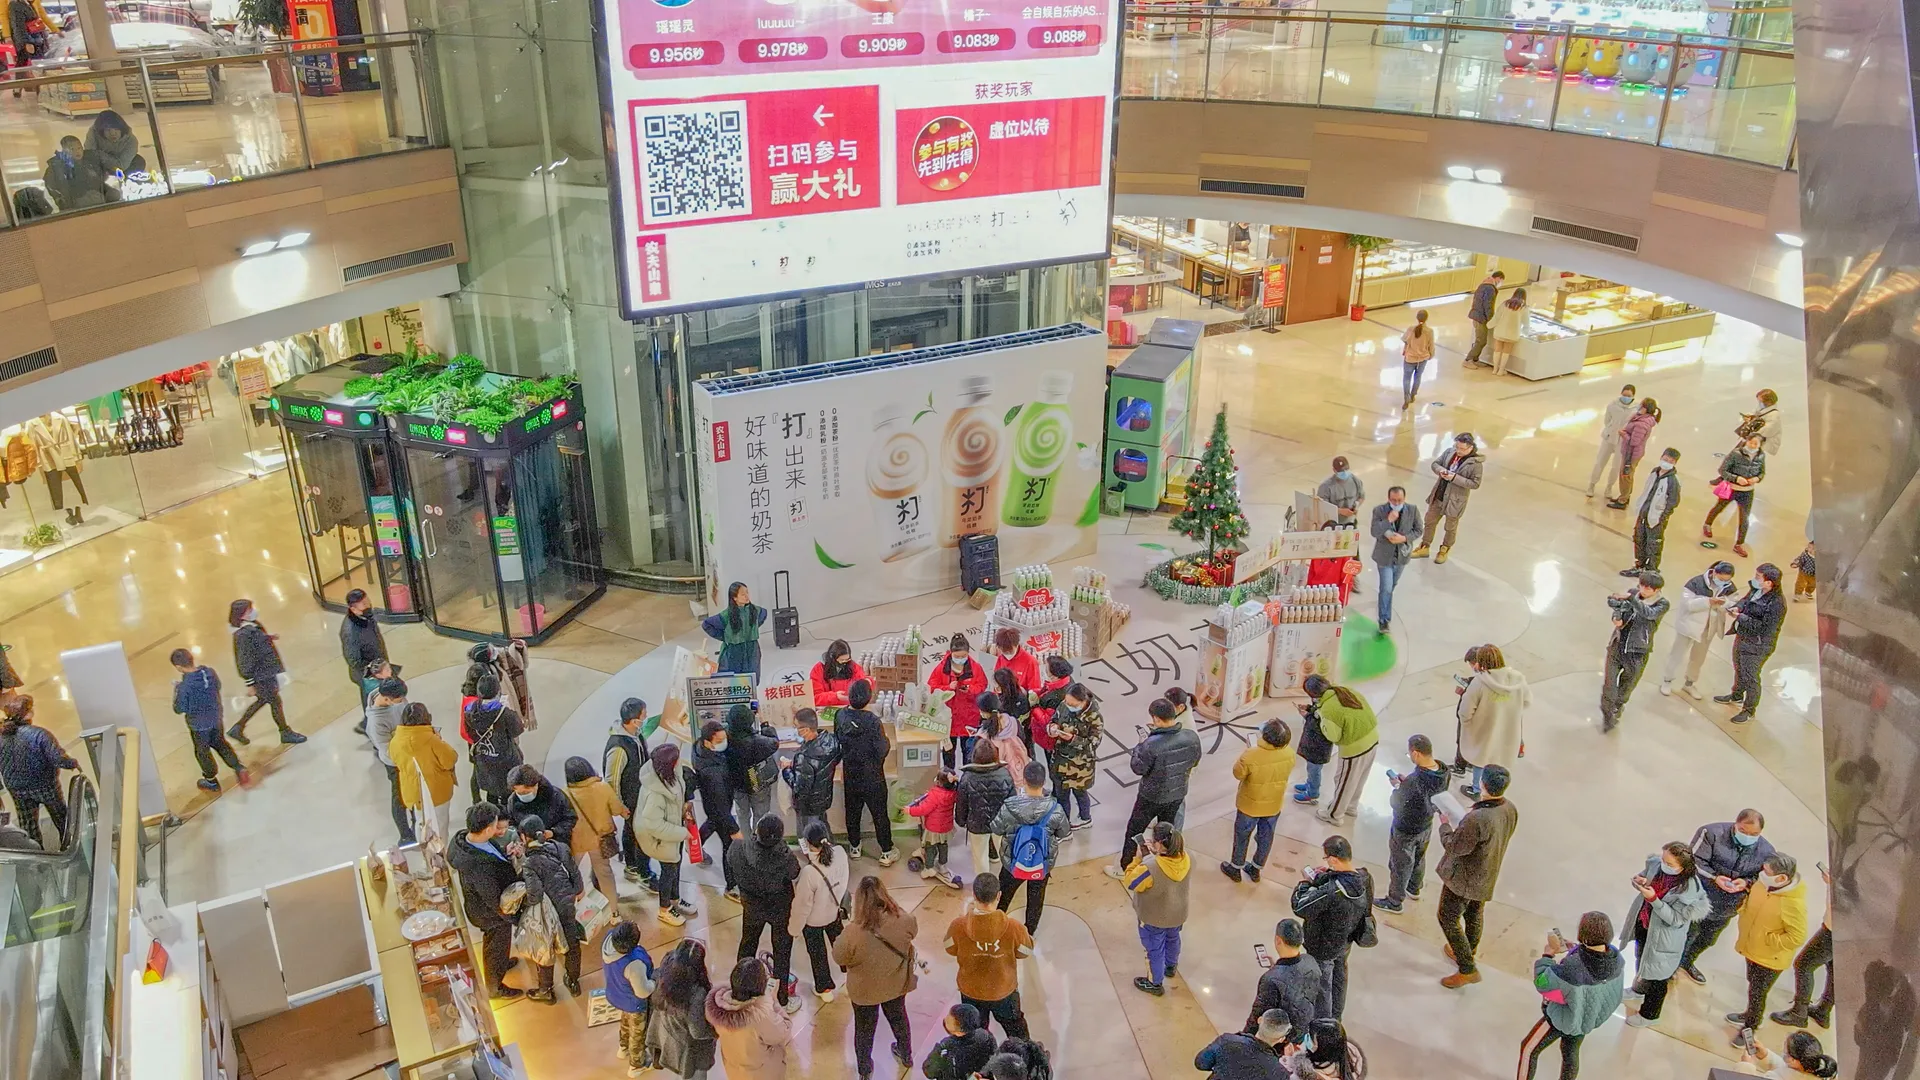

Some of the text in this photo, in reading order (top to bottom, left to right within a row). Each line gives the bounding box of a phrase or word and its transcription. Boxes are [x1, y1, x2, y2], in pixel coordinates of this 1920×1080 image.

[858, 37, 907, 53] 9.909秒
[953, 33, 1000, 48] 9.083秒
[1043, 29, 1087, 44] 9.088秒
[649, 47, 704, 63] 9.956秒
[757, 42, 808, 58] 9.978秒
[975, 81, 1034, 99] 获奖玩家
[989, 117, 1050, 140] 虚位以待
[768, 139, 858, 168] 扫码参与
[919, 132, 974, 160] 参与有奖
[918, 149, 974, 179] 先到先得
[770, 168, 861, 206] 赢大礼
[644, 240, 662, 297] 农夫山泉
[715, 425, 727, 459] 农夫山泉
[745, 415, 774, 555] 好味道的奶茶
[693, 685, 752, 697] 会员无感积分
[765, 683, 805, 700] 核销区
